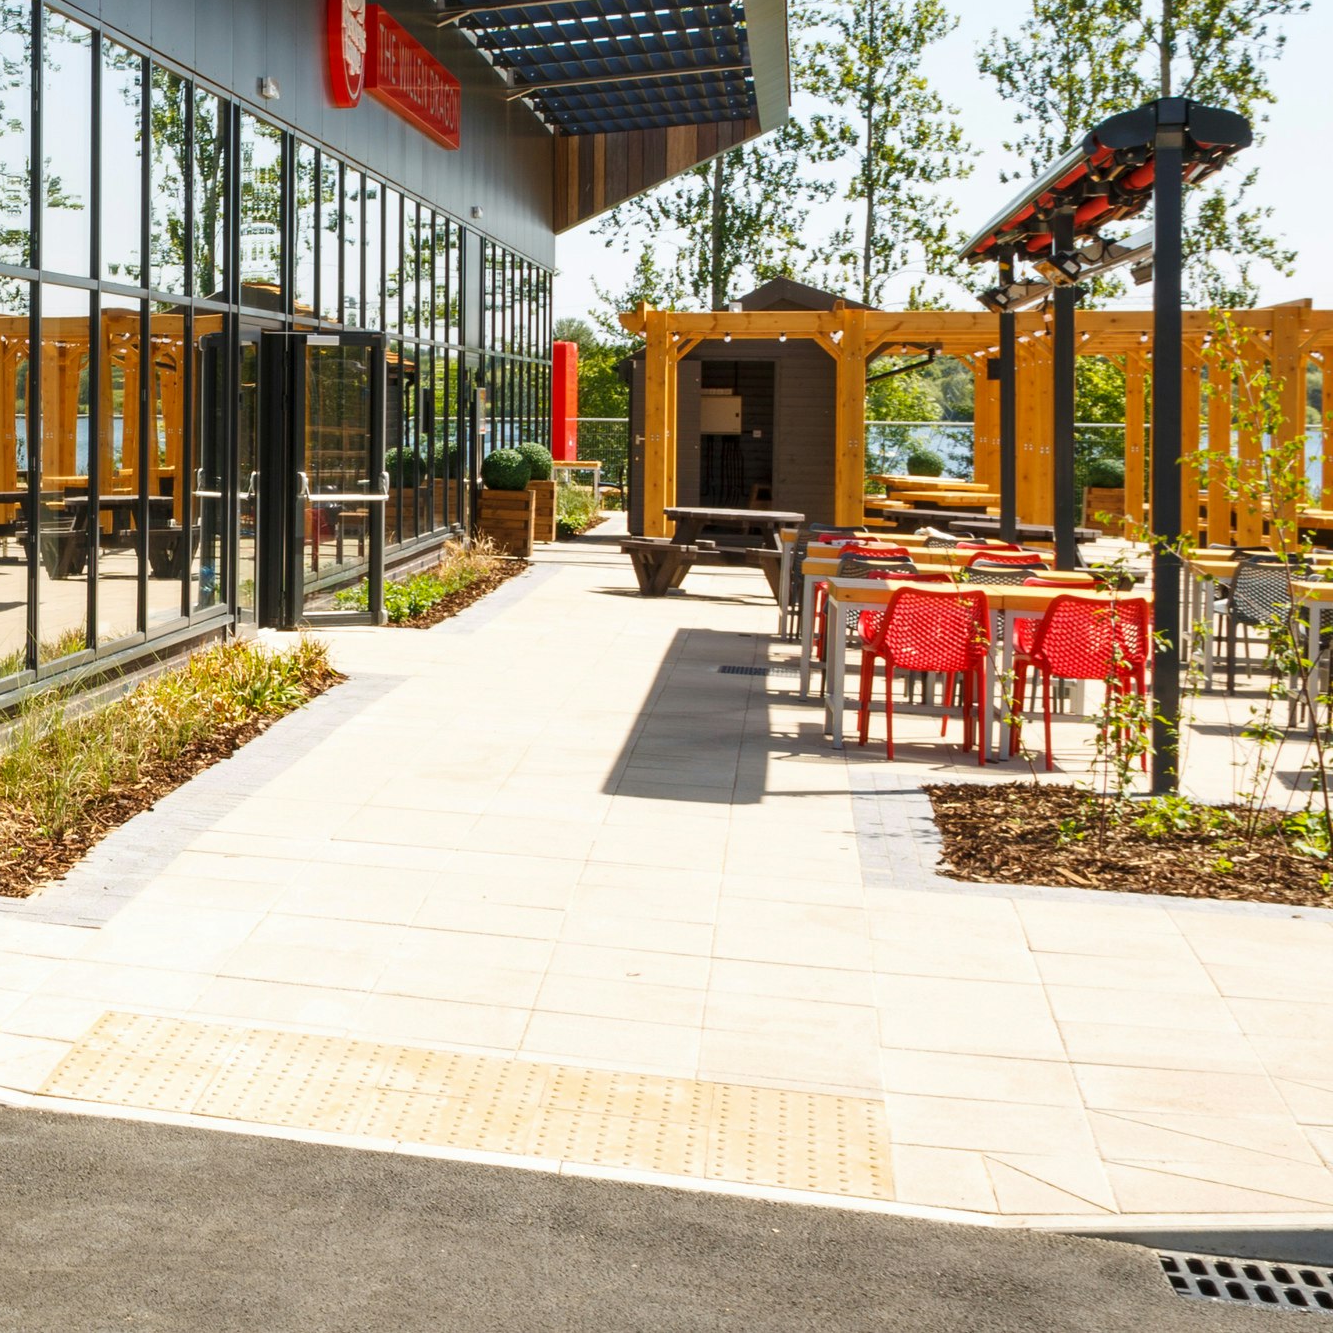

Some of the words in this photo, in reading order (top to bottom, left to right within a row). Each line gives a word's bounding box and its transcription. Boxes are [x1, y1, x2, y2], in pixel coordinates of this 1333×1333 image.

[379, 22, 396, 85] THE
[399, 41, 428, 110] WILLEN
[430, 69, 460, 134] DRAGON
